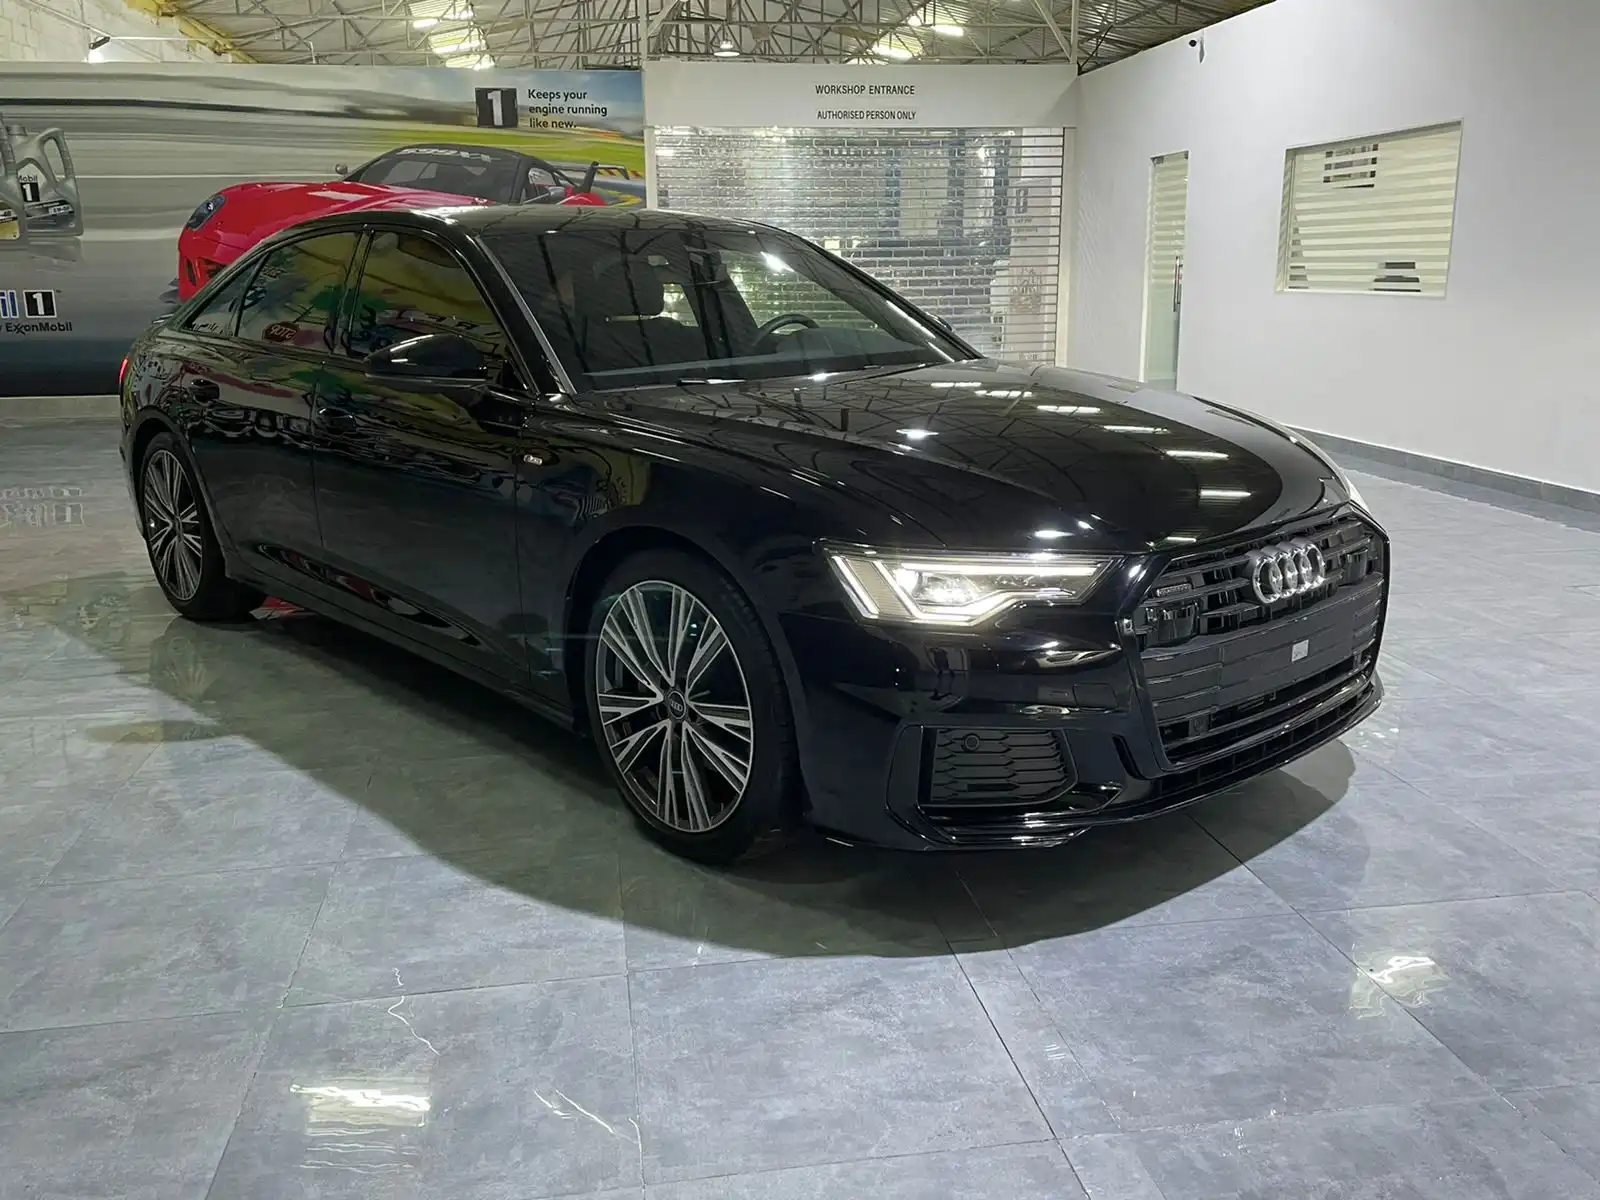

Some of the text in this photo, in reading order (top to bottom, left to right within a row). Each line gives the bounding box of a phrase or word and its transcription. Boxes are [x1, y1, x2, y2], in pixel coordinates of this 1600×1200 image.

[527, 88, 588, 102] Keeps your
[815, 84, 916, 95] WORKSHOP ENTRANCE
[487, 90, 503, 126] 1
[528, 103, 608, 117] engine running
[817, 110, 917, 120] AUTHORISED PERSON ONLY
[529, 117, 577, 128] like new.
[6, 321, 73, 335] ExxonMobil
